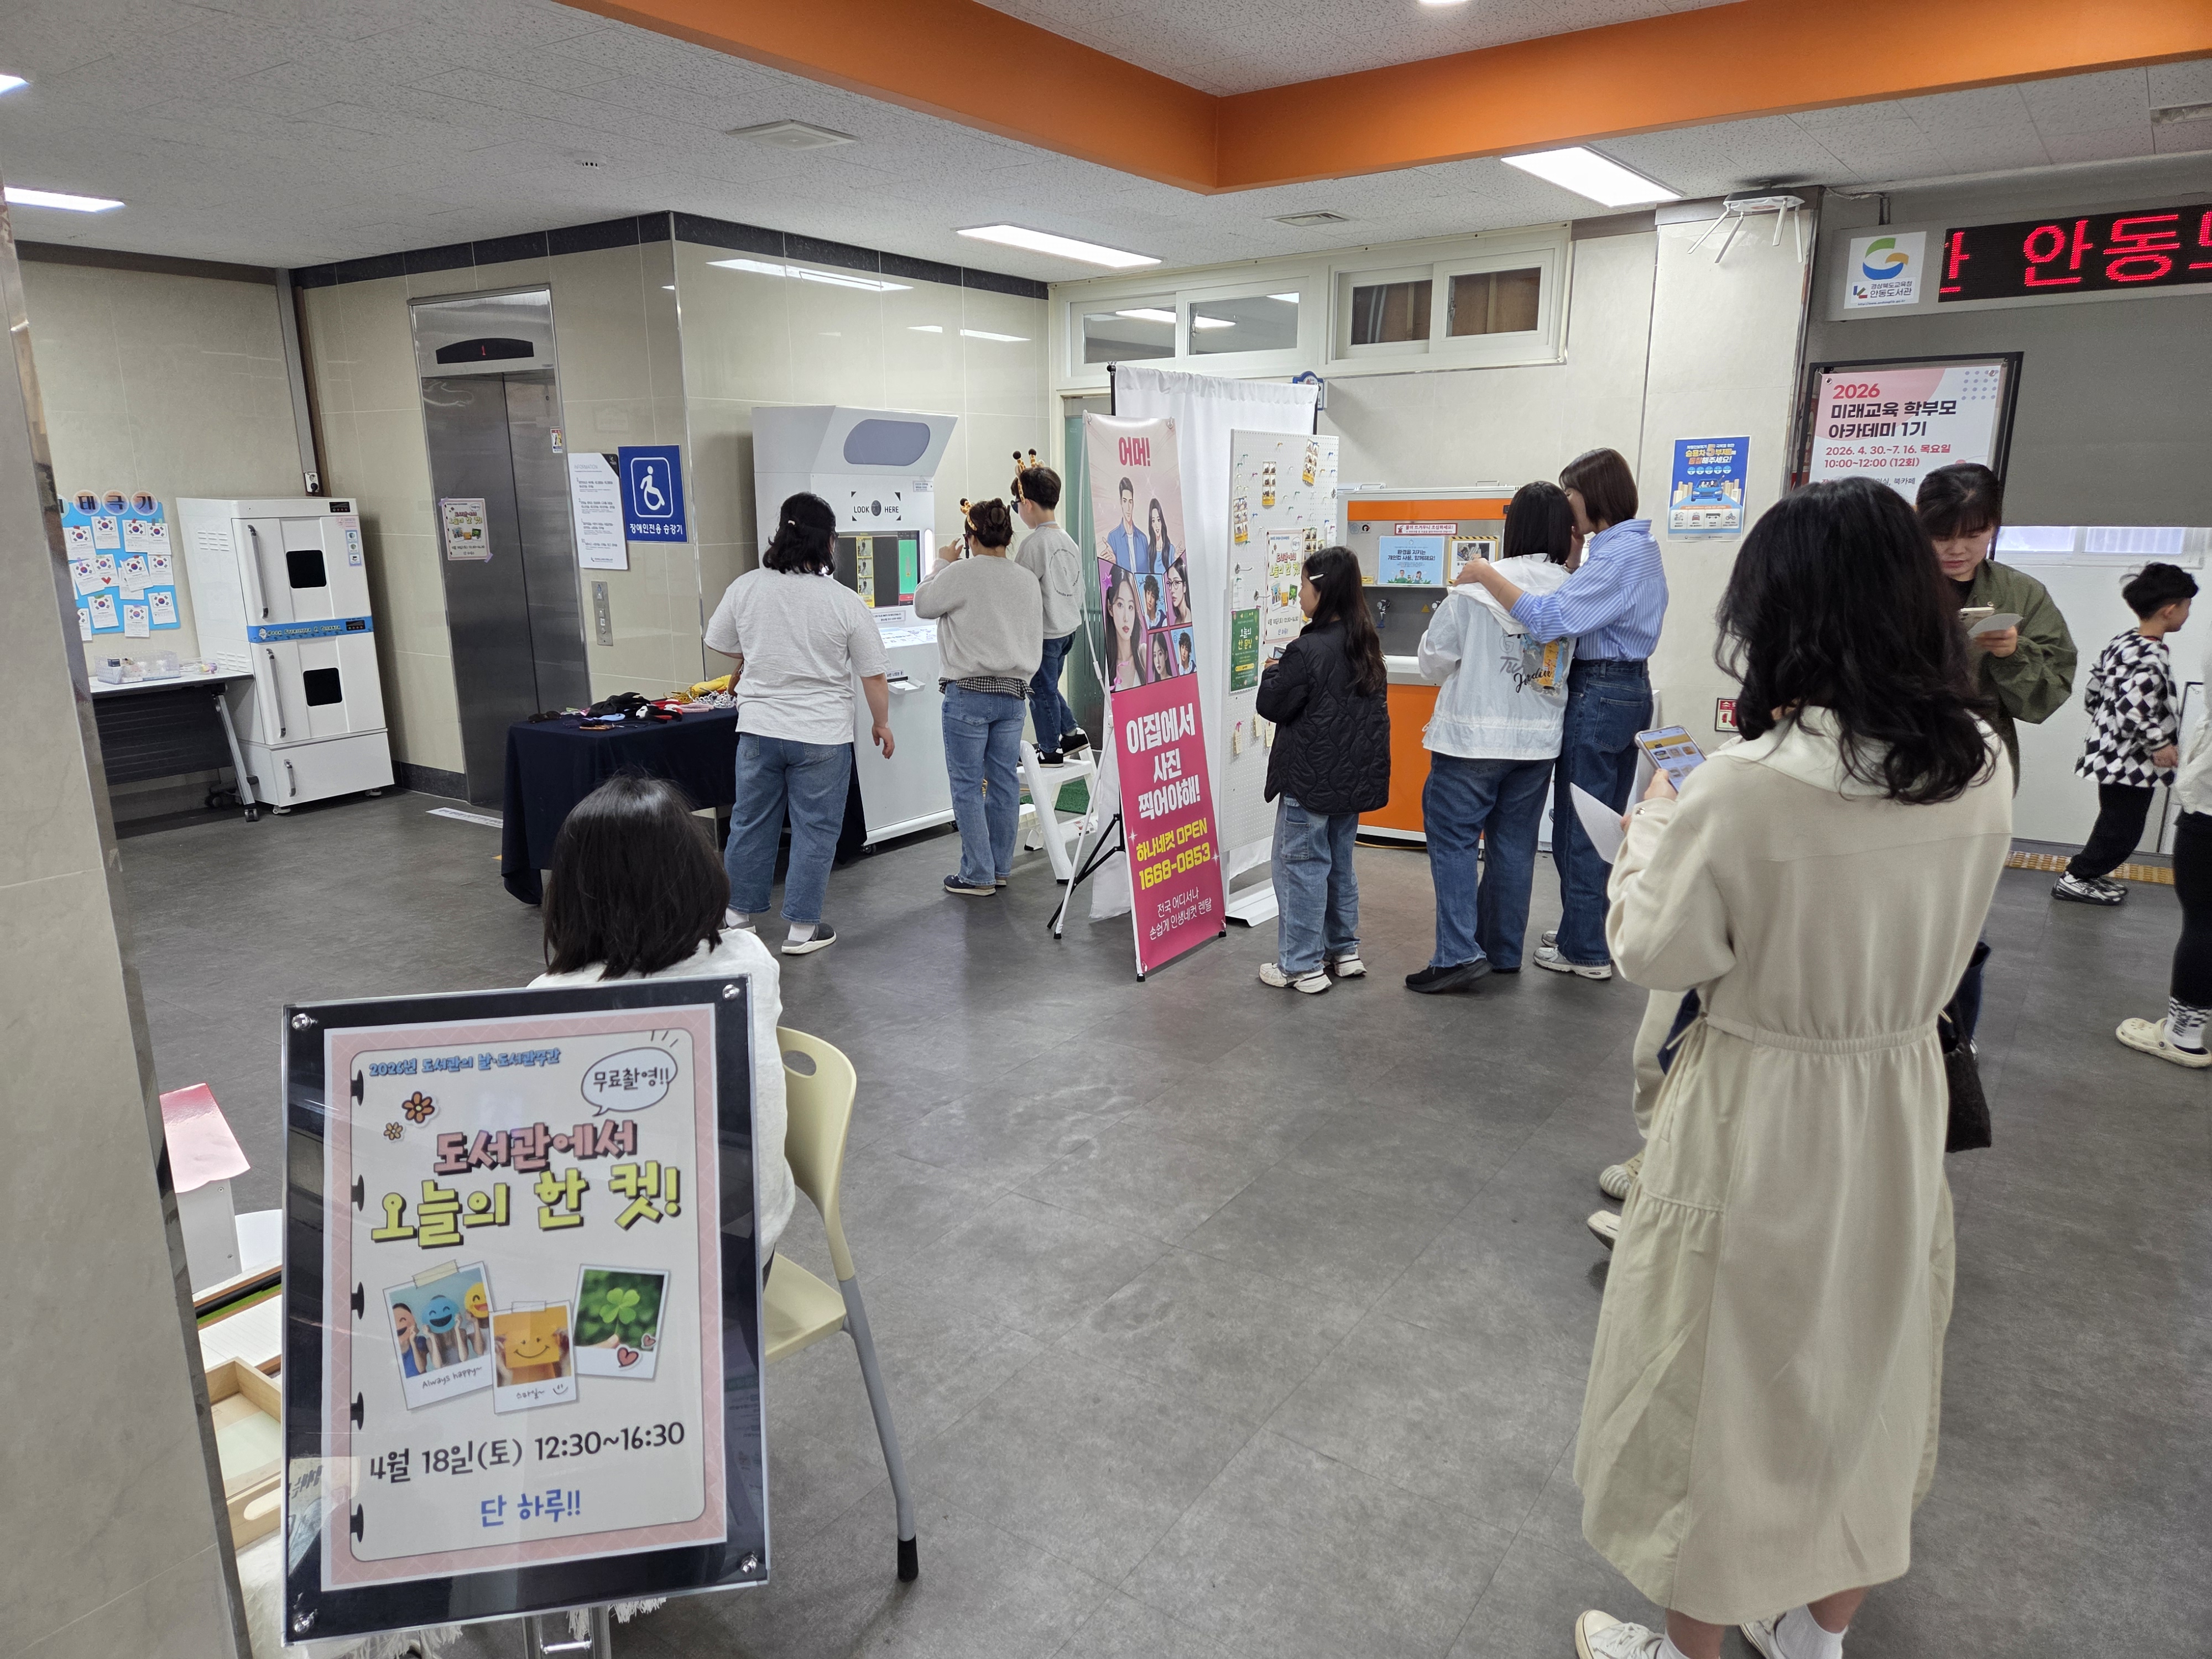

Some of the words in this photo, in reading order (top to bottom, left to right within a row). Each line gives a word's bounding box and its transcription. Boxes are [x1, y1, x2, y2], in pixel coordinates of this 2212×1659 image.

[1870, 288, 1912, 298] 안동도서관
[1871, 281, 1912, 289] 경상북도교육청
[482, 345, 486, 356] 1
[1833, 383, 1880, 399] 2026
[1830, 402, 1899, 419] 미래교육
[1904, 400, 1957, 416] 학부모
[1828, 422, 1896, 439] 아카데미
[1901, 421, 1927, 436] 1기
[1119, 436, 1151, 467] 어머!
[1824, 458, 1887, 468] 10:00~12:00
[1889, 457, 1920, 468] (12회)
[1825, 447, 1855, 456] 2026.
[1858, 446, 1867, 455] 4.
[1903, 445, 1917, 454] 16.
[1920, 444, 1951, 453] 목요일
[629, 523, 661, 534] 장애인전용
[663, 524, 683, 535] 승강기
[1126, 702, 1196, 755] 이집에서
[1153, 748, 1181, 784] 사진
[1138, 774, 1201, 821] 찍어야해!
[1136, 830, 1176, 862] 하나네컷
[1176, 817, 1208, 845] OPEN
[1139, 842, 1211, 890] 1668-0853
[1157, 899, 1171, 918] 전국
[1172, 886, 1199, 909] 어디서나
[1149, 918, 1170, 941] 손쉽게
[1171, 904, 1197, 929] 인생네컷
[1198, 897, 1212, 915] 렌탈
[369, 1058, 417, 1076] 2026년
[421, 1055, 473, 1073] 도서관의
[593, 1068, 670, 1091] 무료촬영!!
[434, 1119, 638, 1175] 도서관에서
[371, 1180, 510, 1249] 오늘의
[534, 1167, 589, 1232] 한
[609, 1160, 682, 1230] 컷!
[422, 1374, 451, 1389] Always
[369, 1448, 411, 1483] 4월
[422, 1439, 523, 1475] 18일(토)
[535, 1421, 685, 1462] 12:30~16:30
[481, 1495, 507, 1527] 단
[517, 1489, 581, 1522] 하루!!
